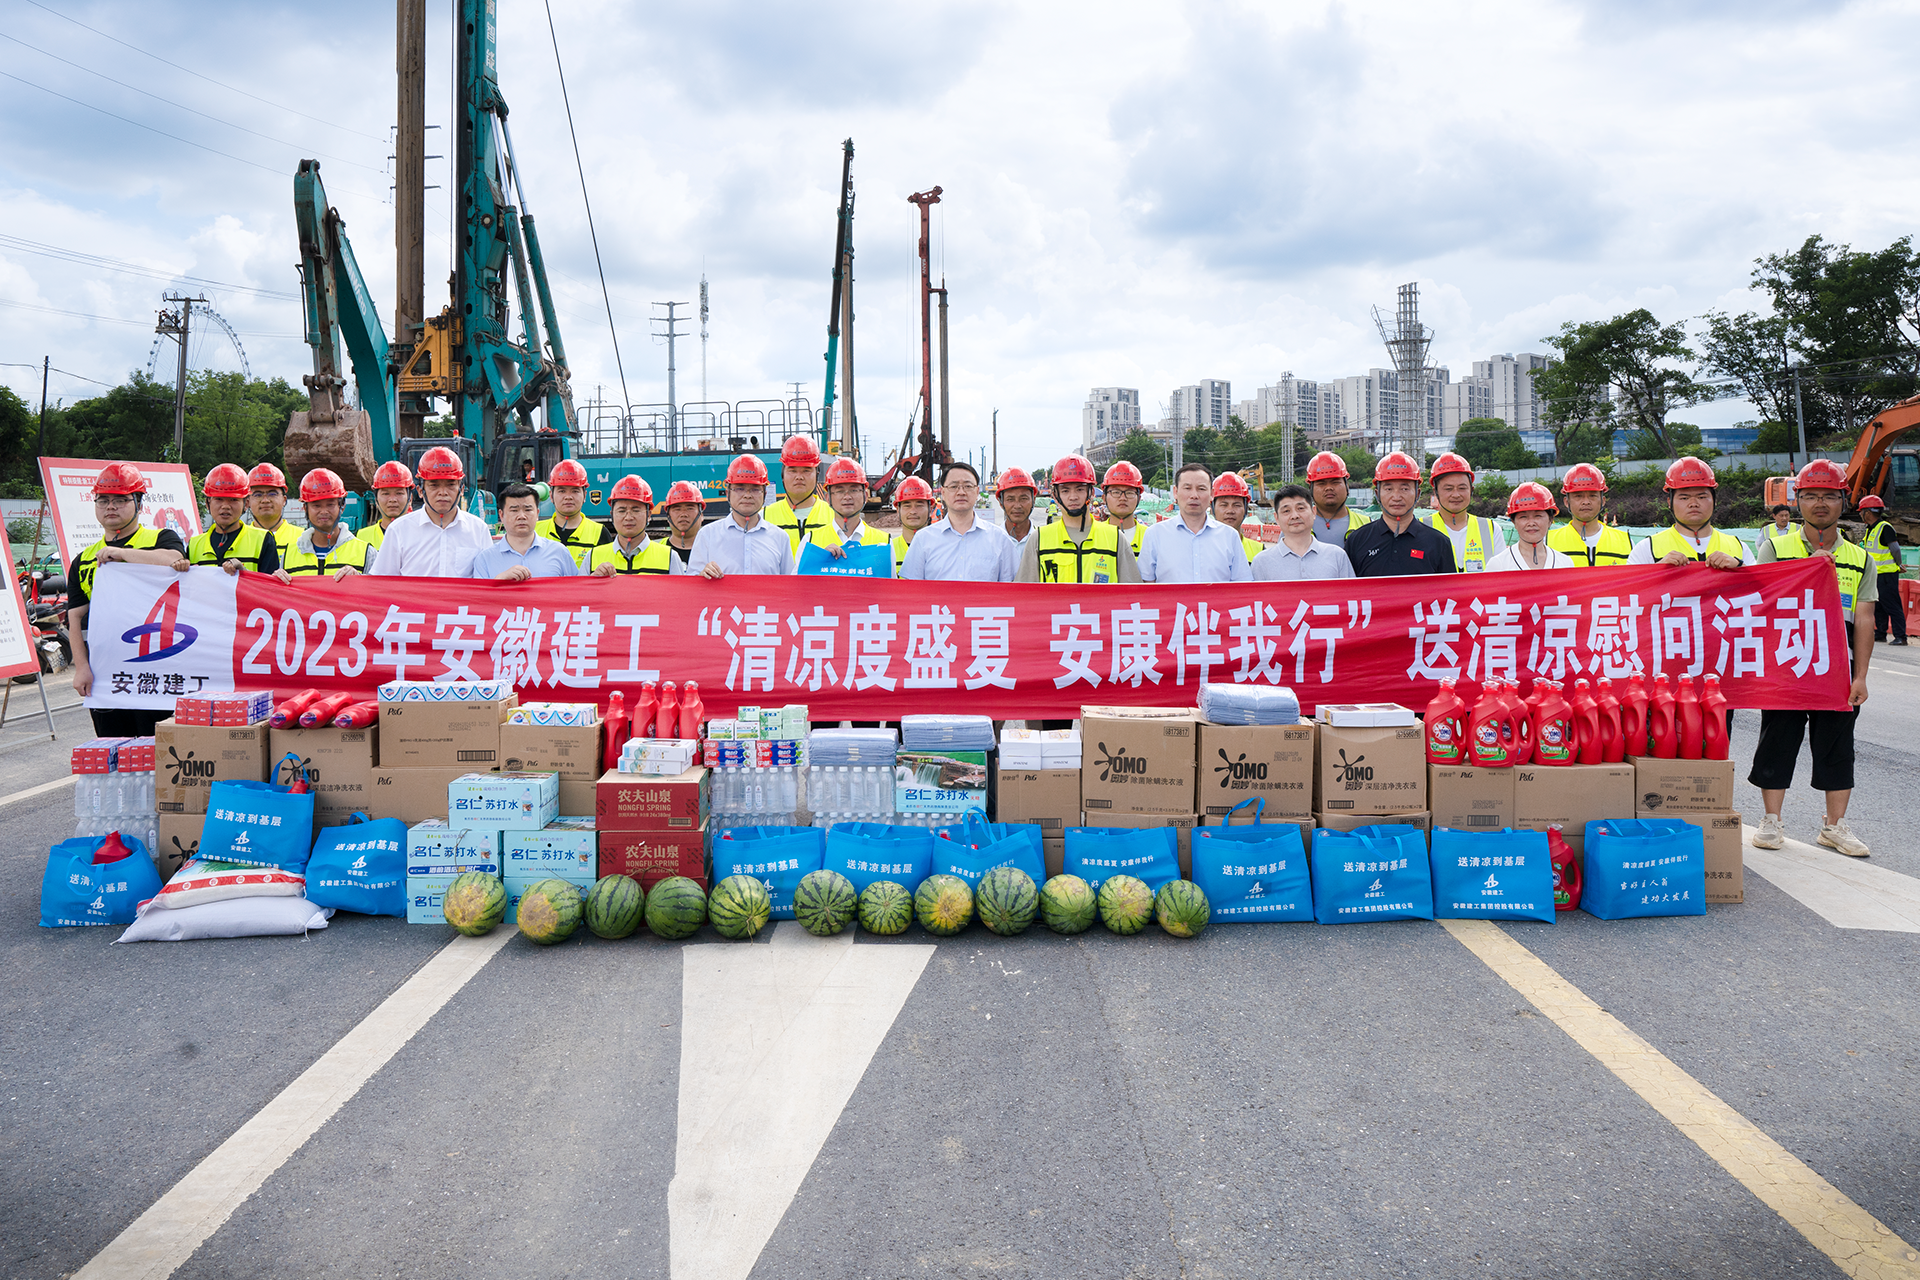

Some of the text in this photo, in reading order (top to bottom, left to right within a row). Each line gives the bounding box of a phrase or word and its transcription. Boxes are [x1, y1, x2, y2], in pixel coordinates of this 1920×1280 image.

[241, 603, 661, 689] 2023年安徽建工
[1406, 588, 1831, 682] 送清凉慰问活动
[111, 671, 210, 696] 安徽建工
[387, 707, 403, 716] P&G
[182, 760, 215, 777] OMO
[1112, 756, 1147, 774] OMO
[1233, 762, 1268, 780] OMO
[1345, 766, 1374, 780] OMO
[1519, 772, 1534, 781] P&G
[377, 776, 392, 785] P&G
[618, 789, 672, 803] 农夫山泉
[935, 789, 969, 801] 苏打水
[485, 799, 519, 810] 苏打水
[215, 808, 282, 827] 送清凉到基层
[334, 839, 399, 852] 送清凉到基层
[444, 846, 477, 858] 苏打水
[625, 845, 680, 859] 农夫山泉
[541, 849, 575, 861] 苏打水
[1457, 856, 1525, 867] 送清凉到基层
[732, 858, 799, 875] 送清凉到基层
[847, 859, 913, 875] 送清凉到基层
[1222, 860, 1287, 876] 送清凉到基层
[1343, 858, 1408, 873] 送清凉到基层
[1452, 902, 1535, 910] 安徽建工集团控股有限公司
